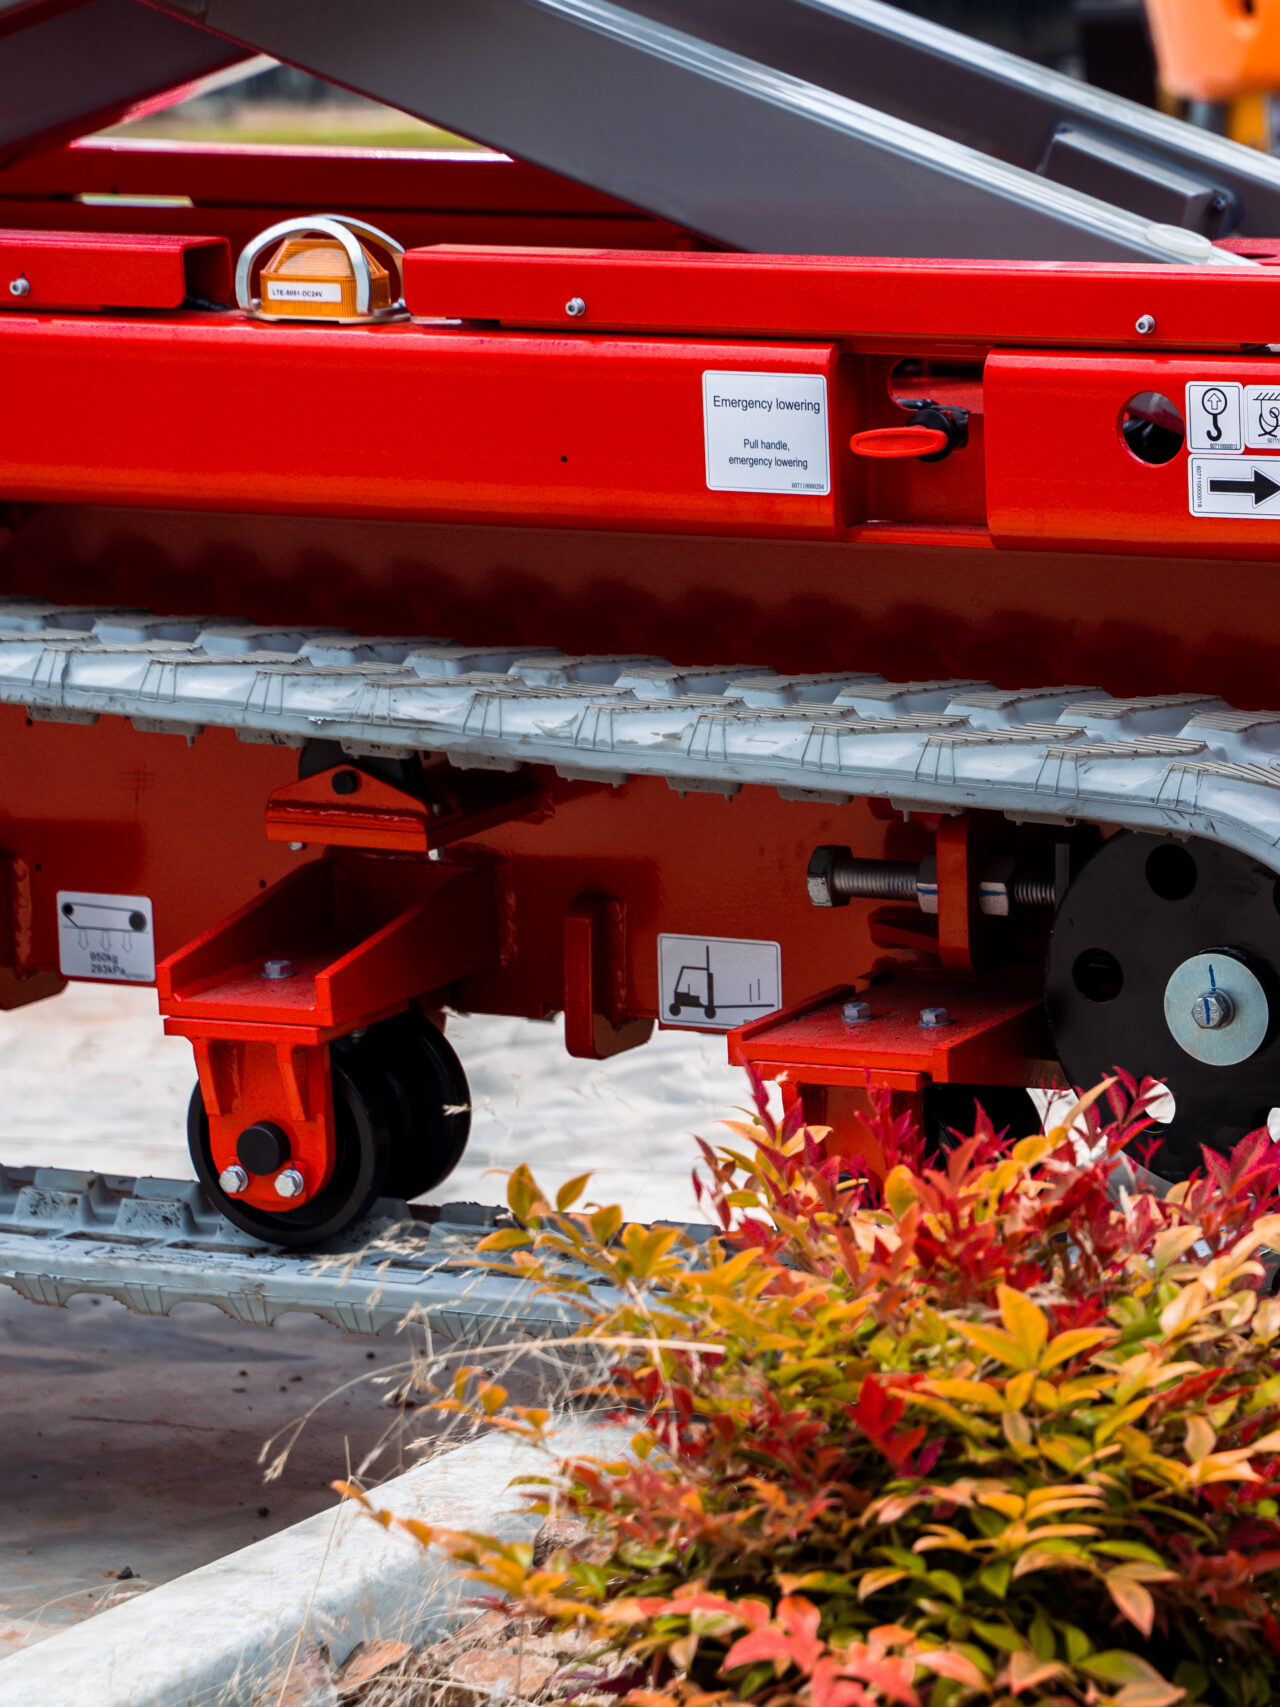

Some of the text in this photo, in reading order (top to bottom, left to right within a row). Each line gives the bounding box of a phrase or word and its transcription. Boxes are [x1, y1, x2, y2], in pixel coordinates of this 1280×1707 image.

[713, 395, 820, 414] Emergency lowering
[743, 438, 790, 452] Pull handle,
[728, 456, 808, 470] emergency lowering
